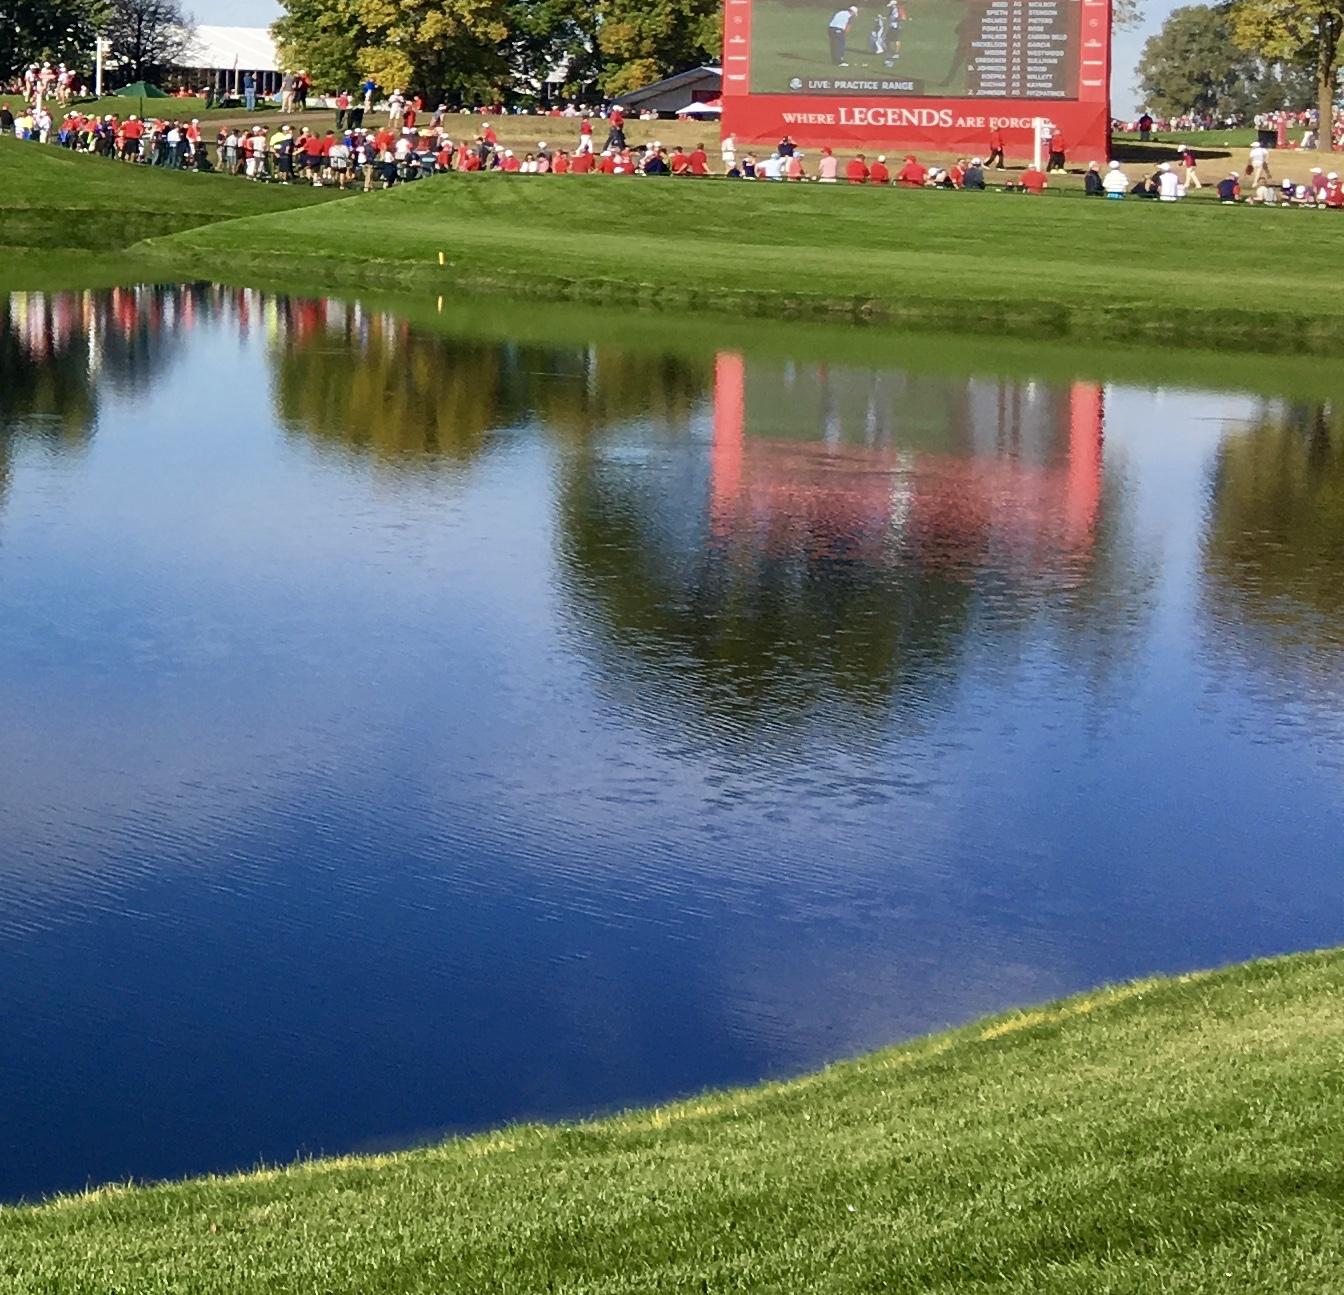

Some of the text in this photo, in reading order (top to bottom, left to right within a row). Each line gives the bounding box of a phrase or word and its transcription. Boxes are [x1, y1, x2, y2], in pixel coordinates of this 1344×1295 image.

[808, 80, 914, 90] LIVE: PRACTICE RANGE
[782, 113, 834, 124] WHERE
[838, 108, 953, 128] LEGENDS
[956, 117, 984, 128] ARE
